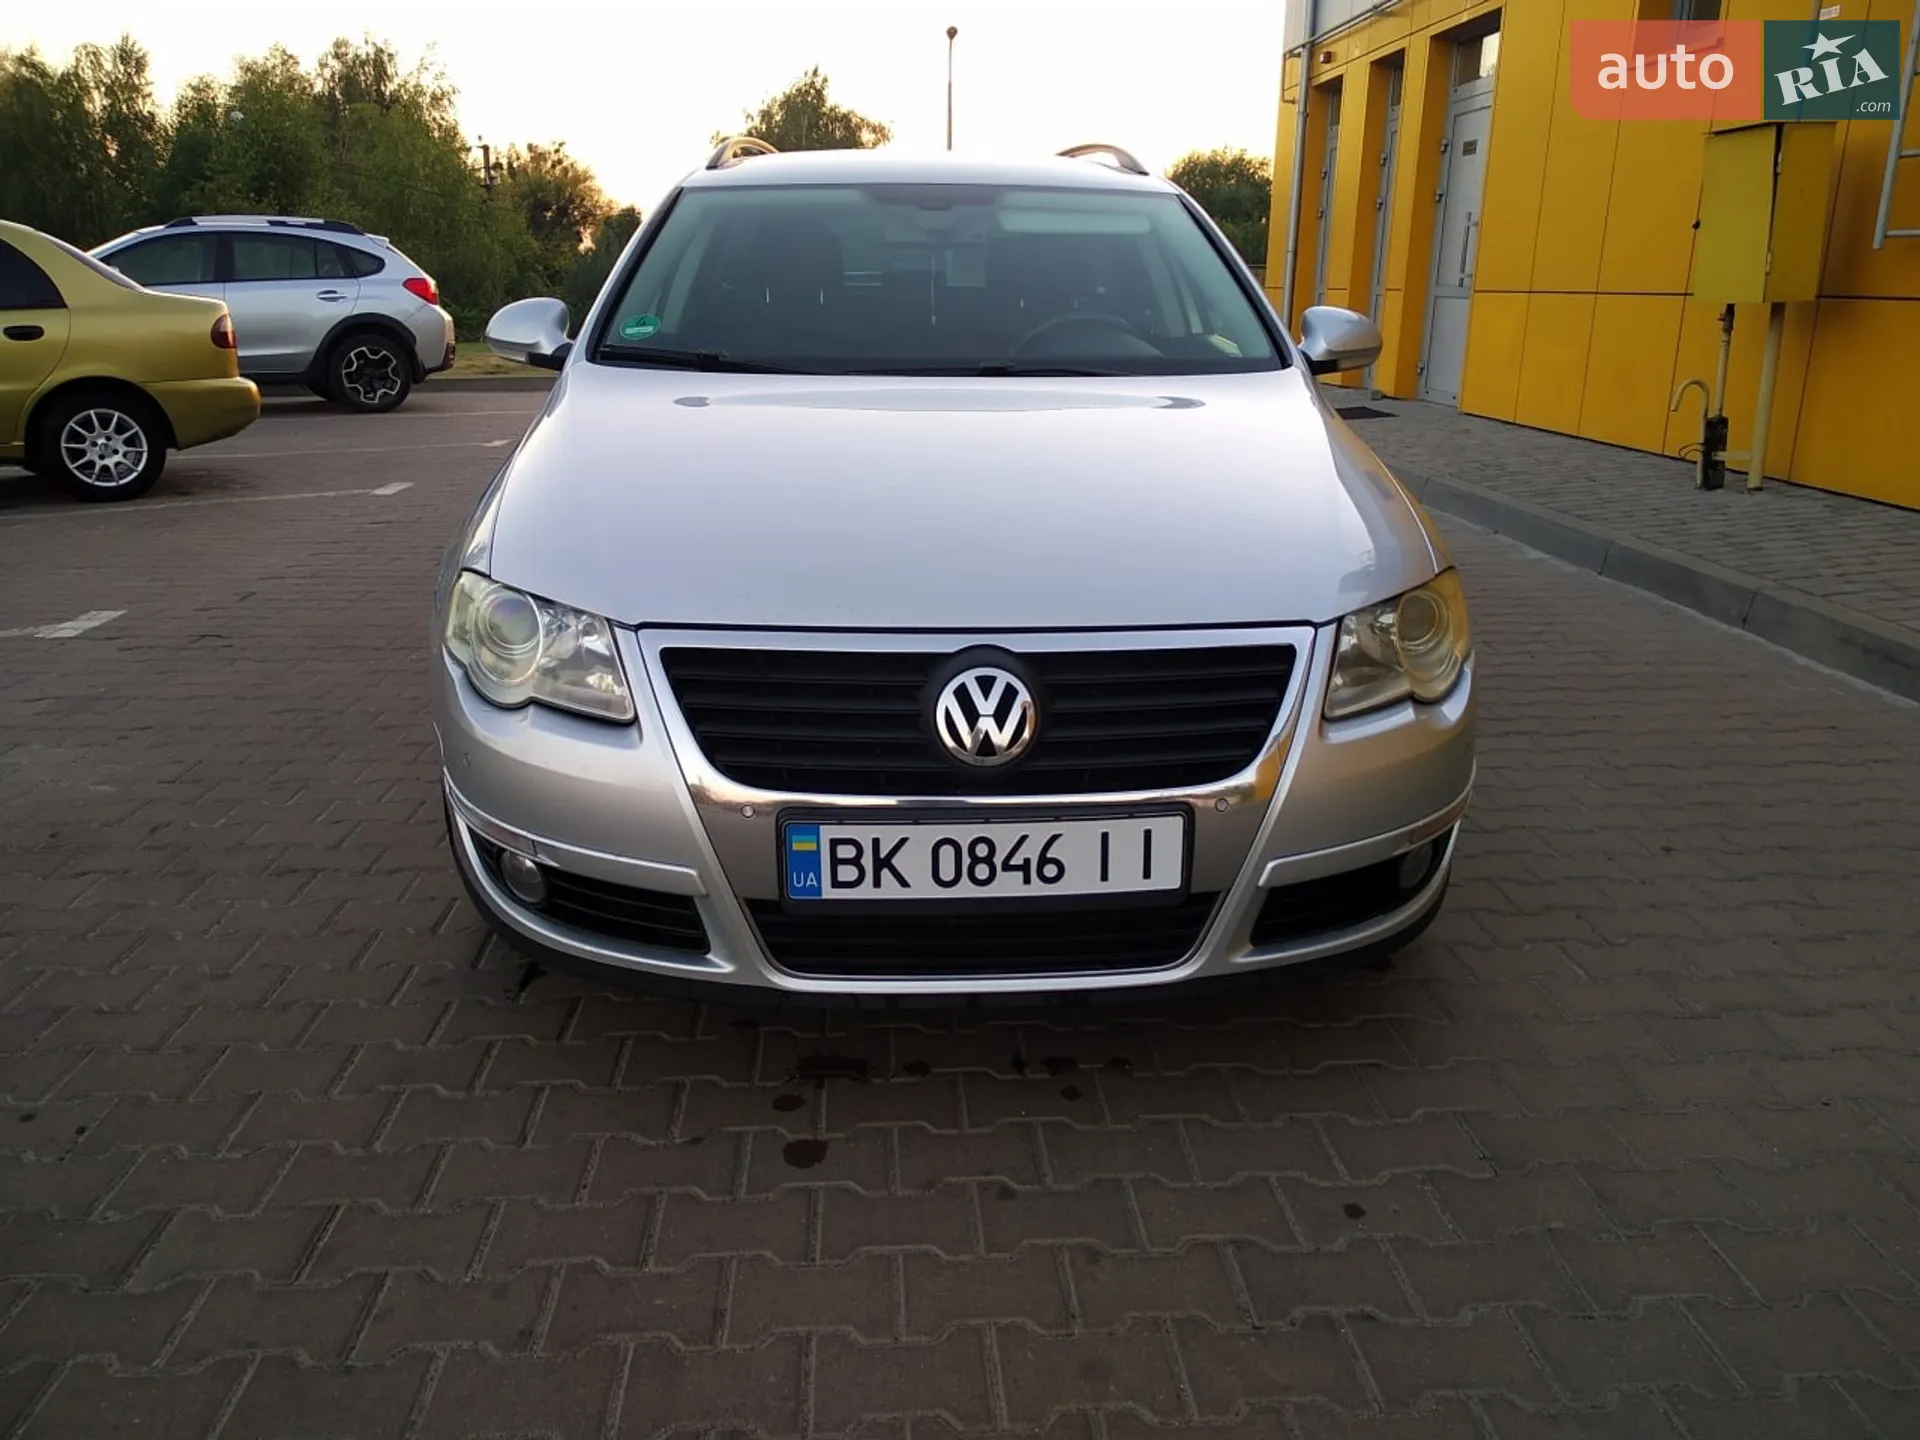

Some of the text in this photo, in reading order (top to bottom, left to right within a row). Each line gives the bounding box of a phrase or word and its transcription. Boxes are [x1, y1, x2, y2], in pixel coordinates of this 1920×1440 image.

[828, 836, 912, 889] BK
[930, 833, 1066, 888] 0846
[792, 871, 818, 888] UA
